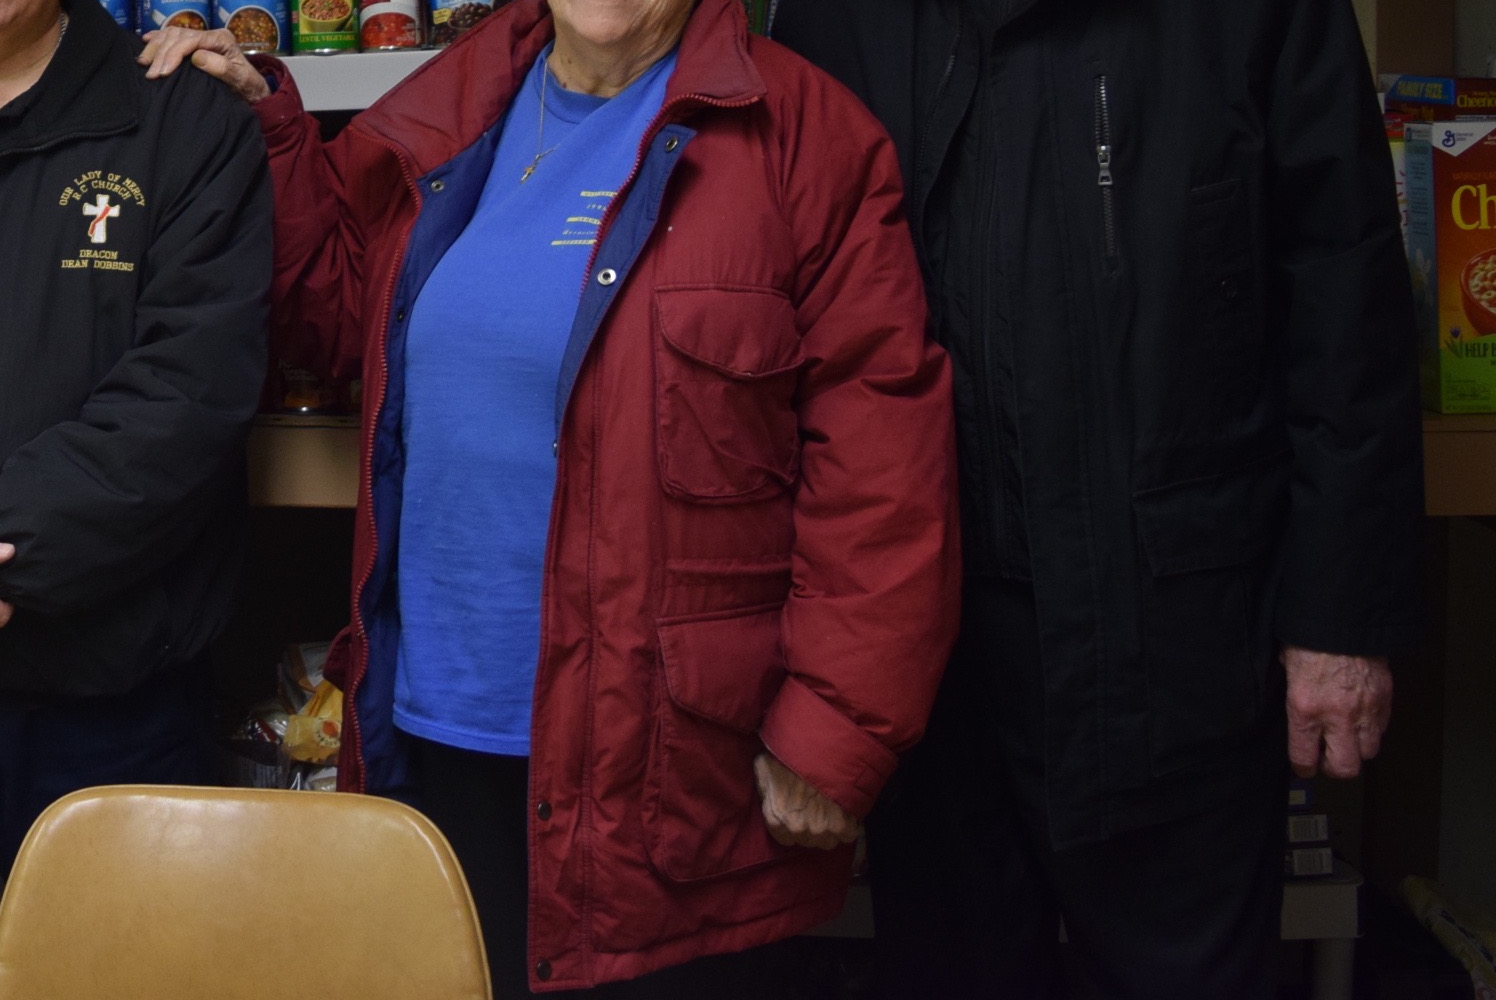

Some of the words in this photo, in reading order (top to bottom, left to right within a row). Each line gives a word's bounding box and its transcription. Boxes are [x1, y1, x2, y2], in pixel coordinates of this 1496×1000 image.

[299, 34, 320, 42] LENTIL
[59, 187, 74, 205] OUR
[74, 171, 102, 185] LADY
[107, 173, 121, 182] OF
[122, 178, 145, 206] MERCY
[72, 192, 81, 200] R
[80, 184, 88, 193] C
[91, 180, 132, 200] CHURCH
[79, 249, 118, 260] DEACON
[61, 259, 89, 268] DEAN
[94, 260, 134, 272] DOBBINS
